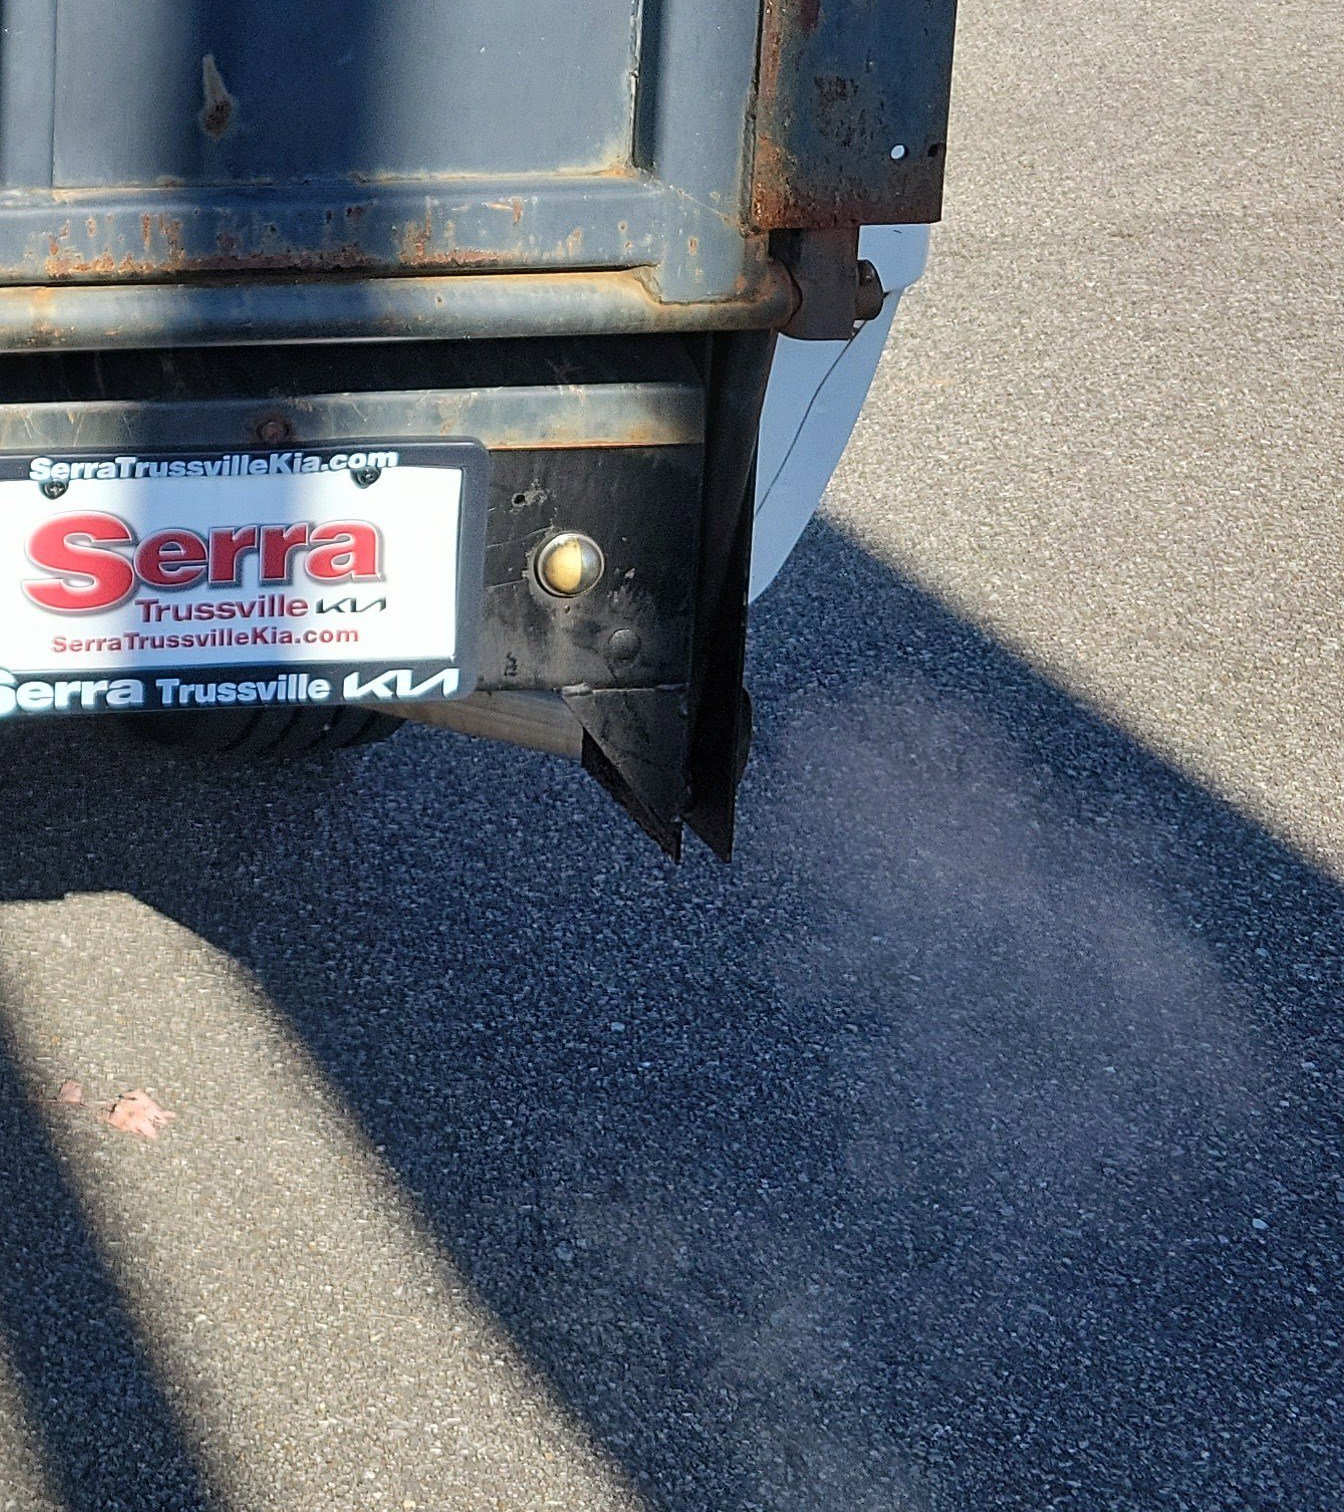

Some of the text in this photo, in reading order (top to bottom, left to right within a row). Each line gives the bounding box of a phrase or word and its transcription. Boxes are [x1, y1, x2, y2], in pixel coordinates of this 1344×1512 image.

[29, 451, 398, 481] SerraTrussvilleKia.com
[21, 509, 386, 616] Serra
[134, 594, 309, 623] Trussville
[52, 626, 360, 653] SerraTrussvilleKia.com
[155, 673, 331, 706] Trussville
